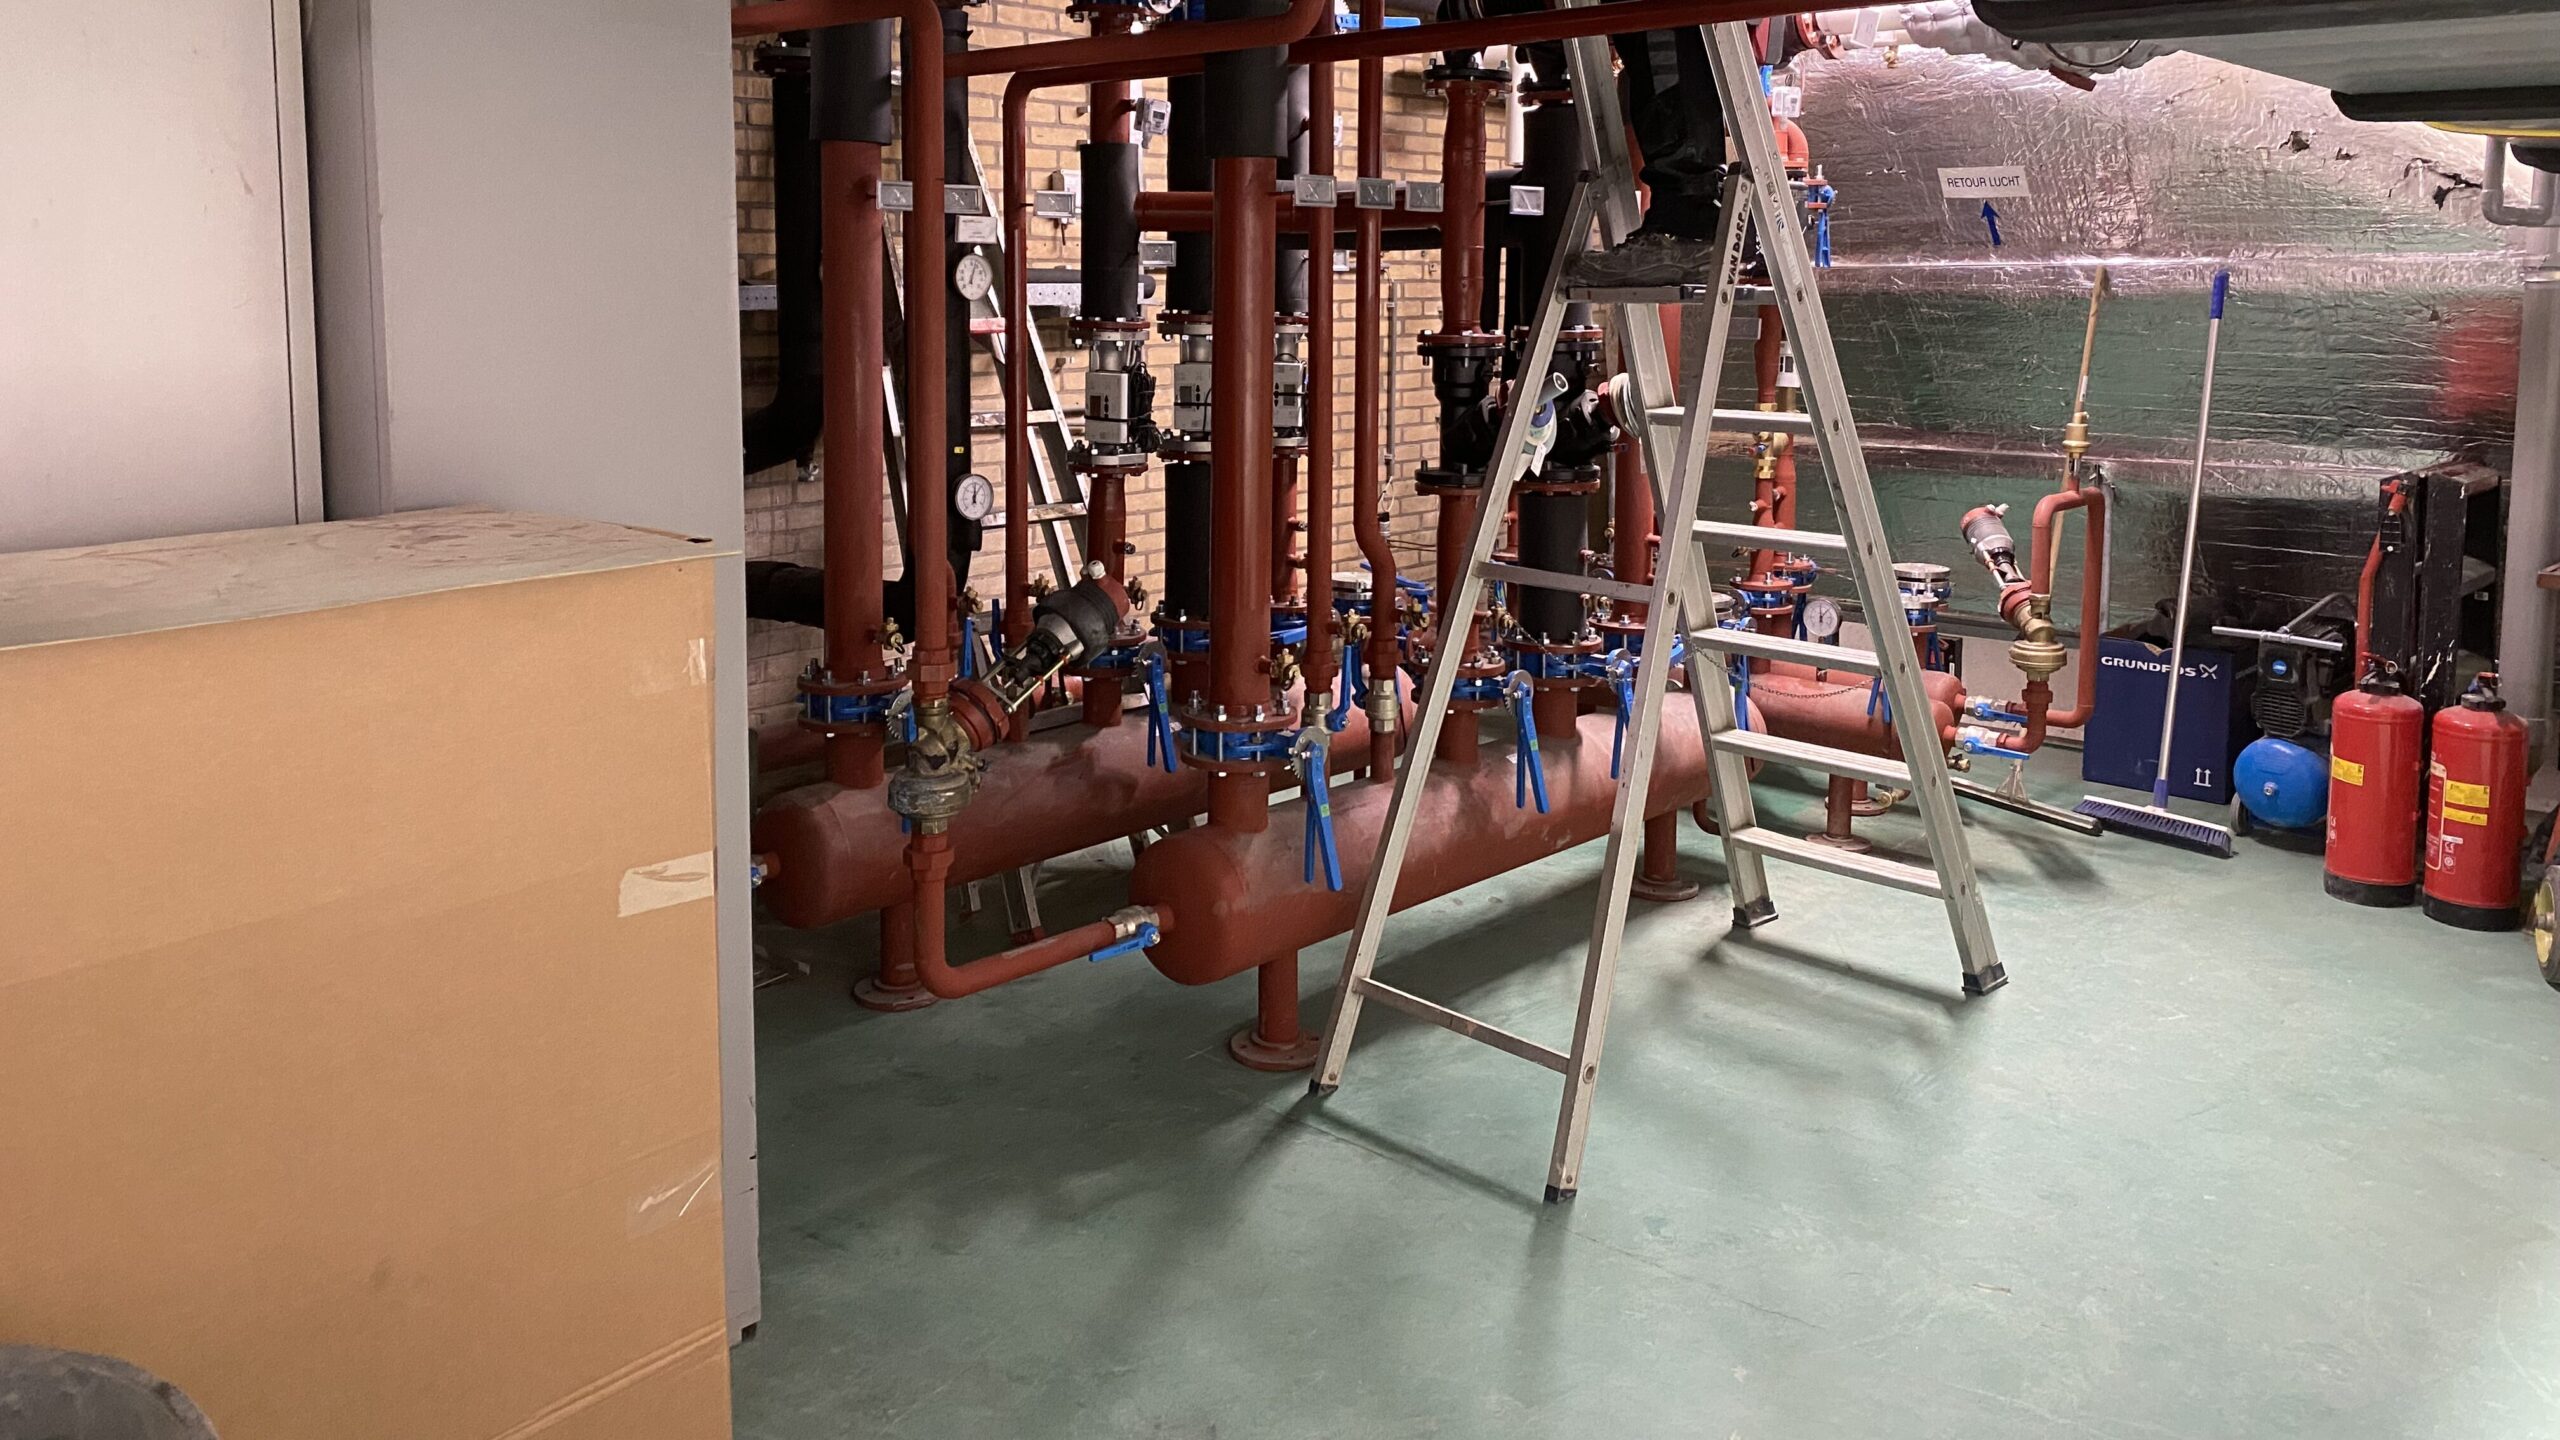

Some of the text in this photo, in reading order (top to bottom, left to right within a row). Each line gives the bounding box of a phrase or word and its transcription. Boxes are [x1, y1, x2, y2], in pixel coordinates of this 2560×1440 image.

[1946, 175, 2020, 188] RETOUR LUCHT
[1726, 253, 1739, 285] VAN
